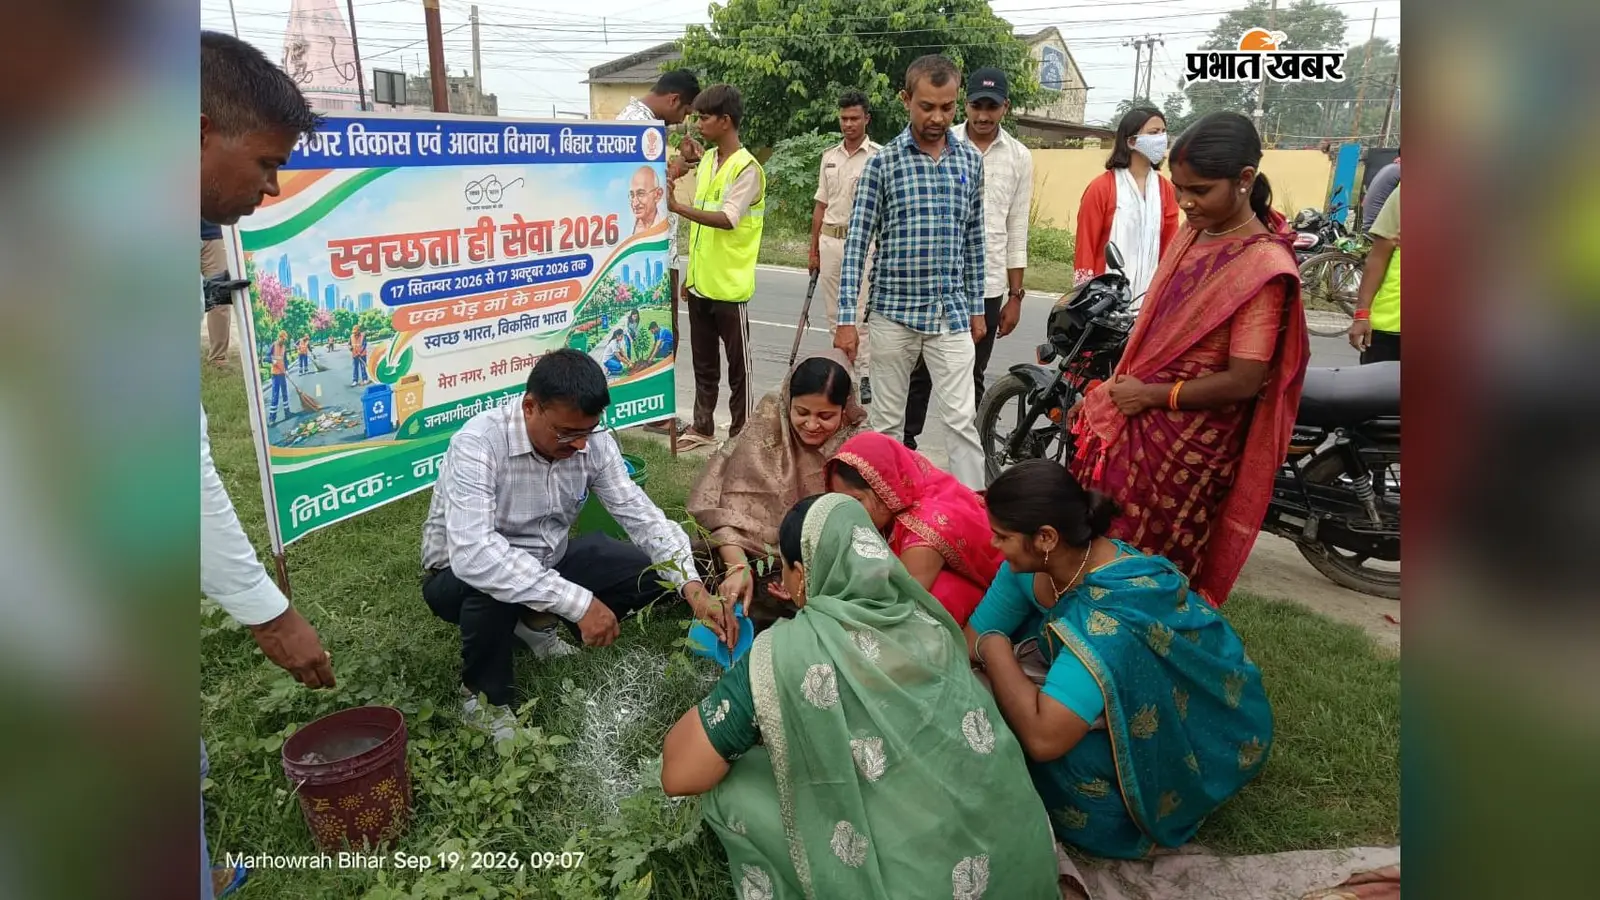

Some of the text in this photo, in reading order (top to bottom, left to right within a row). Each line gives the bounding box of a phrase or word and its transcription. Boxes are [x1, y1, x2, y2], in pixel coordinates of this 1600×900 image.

[346, 122, 411, 156] विकास
[416, 124, 442, 156] एवं
[448, 132, 499, 156] आवास
[503, 126, 556, 156] विभाग,
[559, 127, 593, 155] बिहार
[596, 134, 637, 154] सरकार
[327, 213, 619, 279] स्वच्छता ही सेवा 2026
[390, 258, 587, 299] 17 सितम्बर 2026 से 17 अक्टूबर 2026 तक
[407, 284, 571, 325] एक पेड़ मां के नाम
[424, 309, 568, 350] स्वच्छ भारत, विकसित भारत
[438, 373, 457, 389] मेरा
[460, 368, 486, 384] नगर,
[490, 360, 508, 377] मेरी
[424, 399, 483, 428] जनभागीदारी
[485, 395, 494, 409] से
